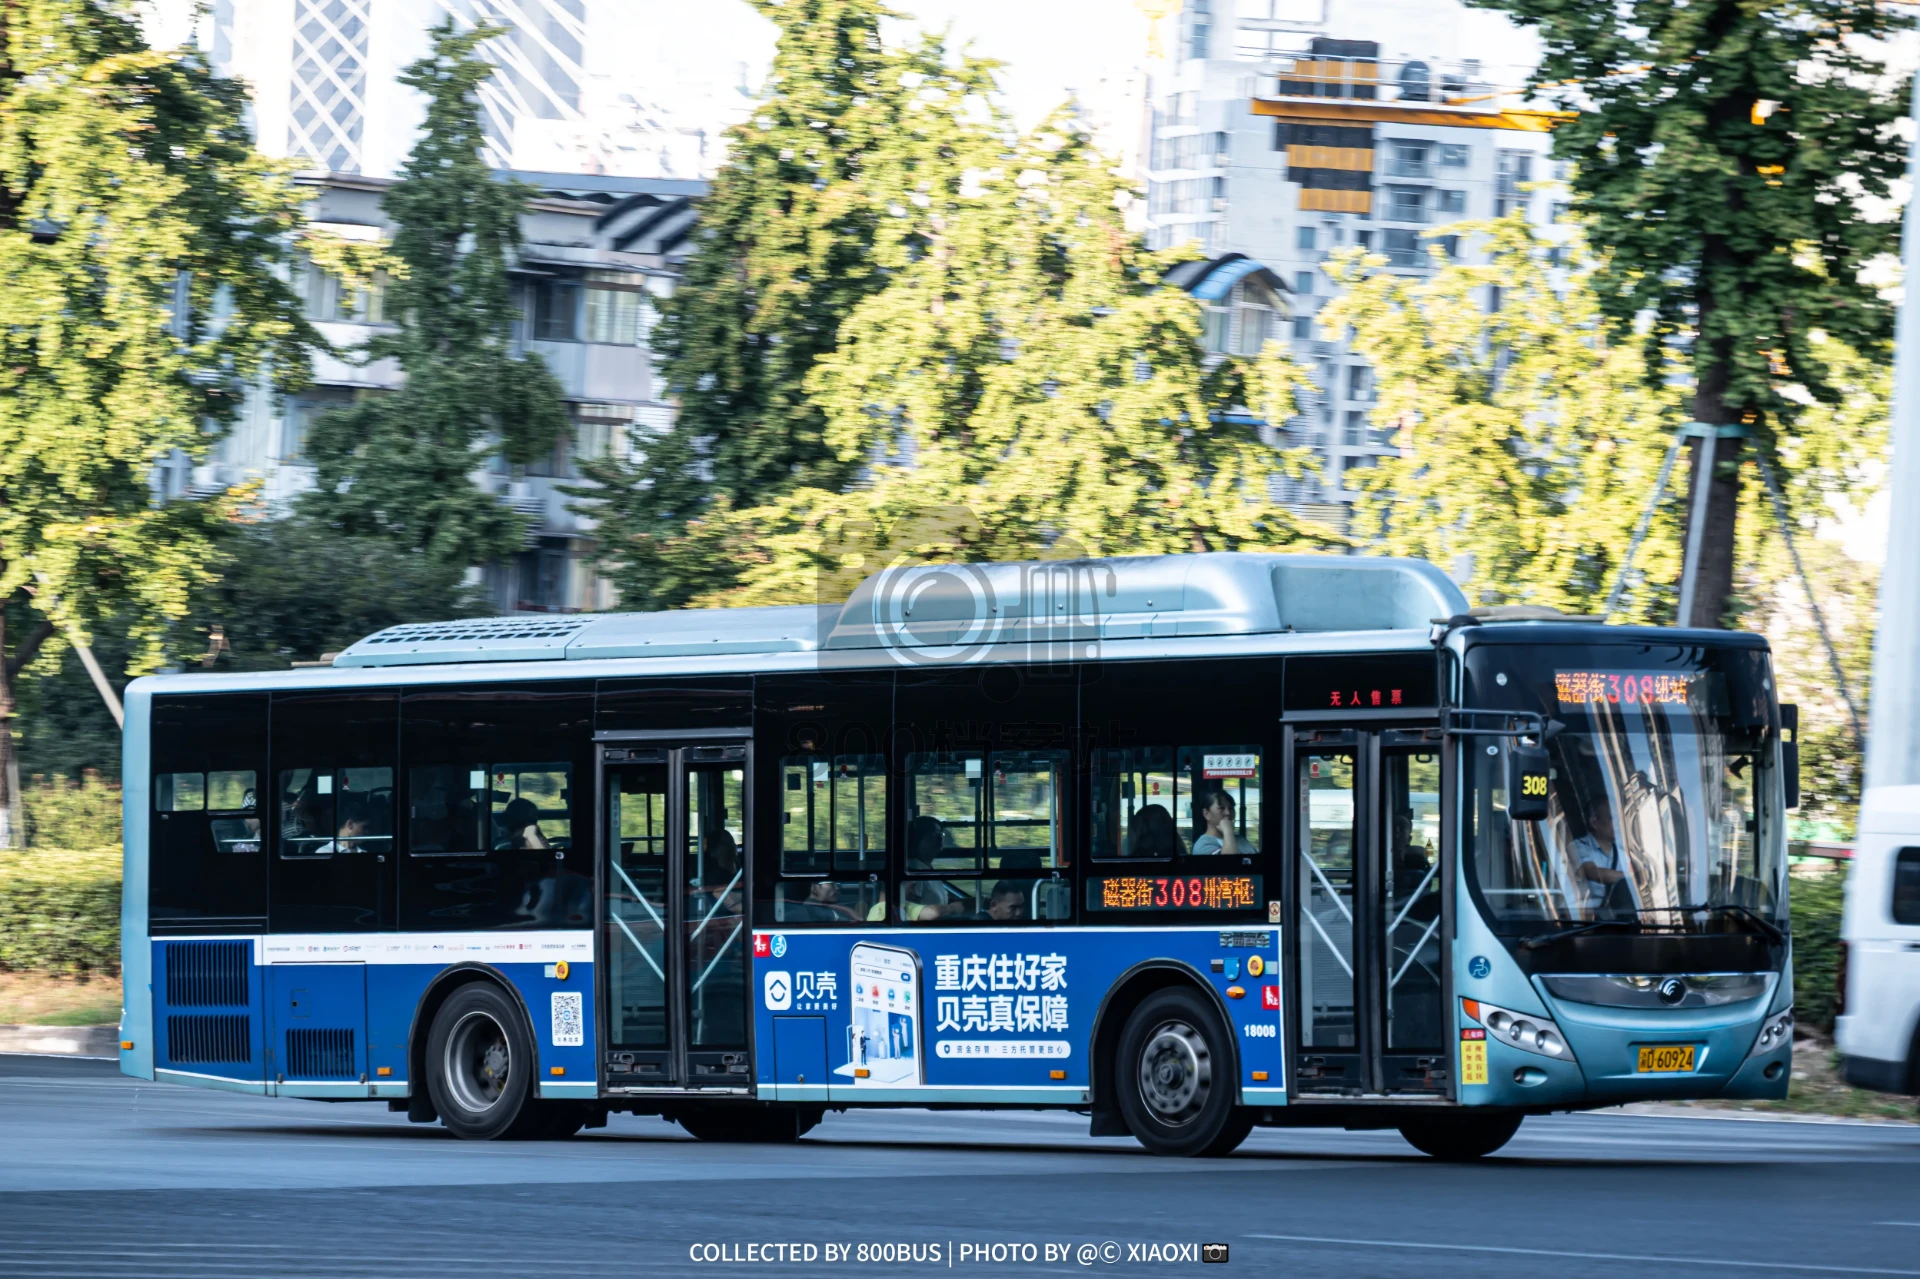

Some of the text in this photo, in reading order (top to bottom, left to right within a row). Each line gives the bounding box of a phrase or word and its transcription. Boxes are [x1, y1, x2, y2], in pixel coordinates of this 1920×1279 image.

[1330, 689, 1403, 706] 无人售票
[1607, 674, 1654, 704] 308
[1522, 775, 1548, 796] 308
[1103, 877, 1153, 908] 磁器街
[1155, 878, 1202, 907] 308
[796, 971, 837, 1000] 贝壳
[934, 952, 1068, 992] 重庆住好家
[935, 994, 1069, 1033] 贝壳真保障
[1244, 1024, 1276, 1038] 18008
